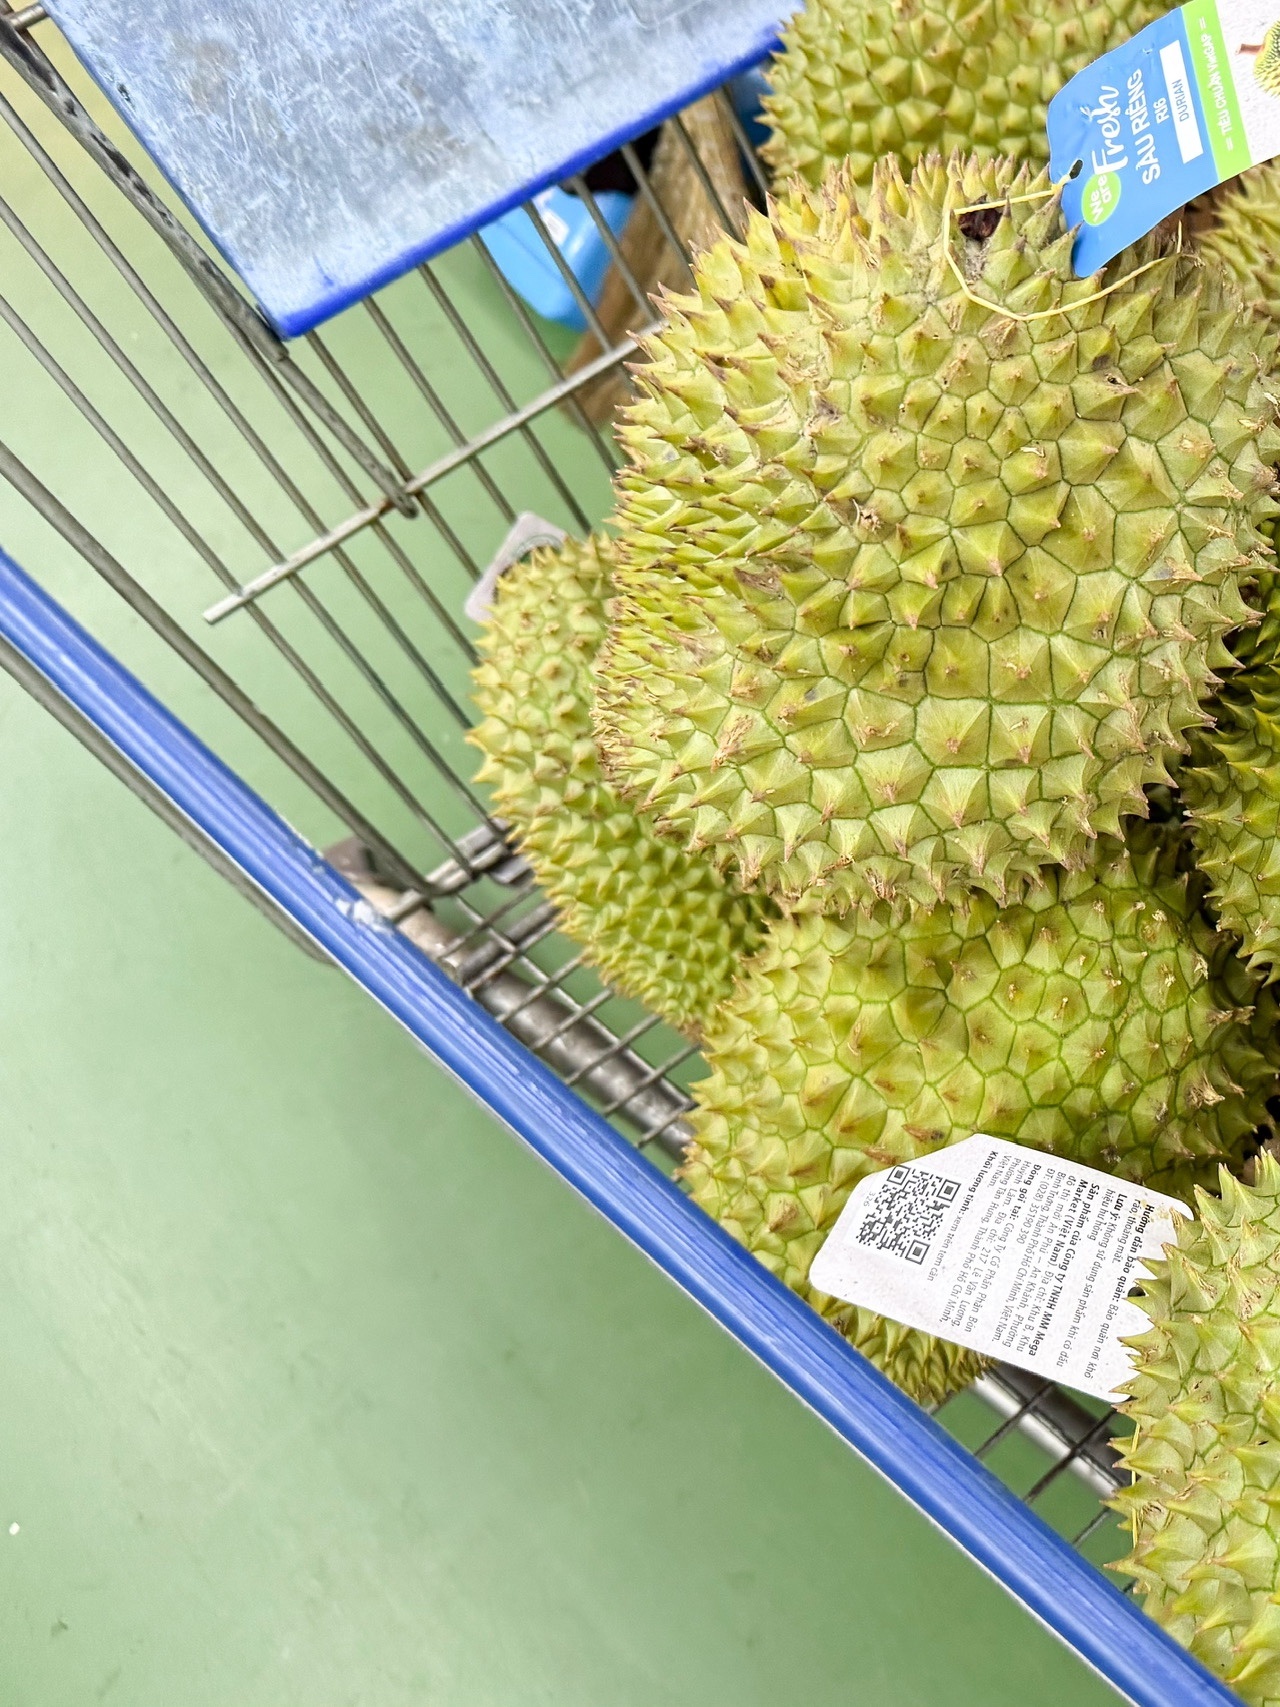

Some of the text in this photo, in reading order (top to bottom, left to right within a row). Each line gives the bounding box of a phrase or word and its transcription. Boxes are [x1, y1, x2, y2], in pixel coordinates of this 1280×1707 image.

[1125, 69, 1151, 135] RIÊNG
[1171, 80, 1190, 123] DURIAN
[1092, 85, 1129, 175] Fresh
[1096, 173, 1114, 204] are
[1088, 191, 1104, 221] We
[1032, 1180, 1049, 1201] (028)
[1067, 1178, 1090, 1213] Market
[949, 1215, 962, 1231] xem
[997, 1221, 1014, 1242] Công
[1046, 1221, 1060, 1234] An
[933, 1249, 946, 1266] tem
[977, 1246, 991, 1264] 217
[1046, 1239, 1065, 1268] Nam).
[1057, 1247, 1076, 1271] Công
[1029, 1265, 1041, 1279] An
[1053, 1272, 1066, 1283] ty
[1045, 1284, 1063, 1310] TNHH
[1027, 1303, 1041, 1322] Khu
[1038, 1310, 1053, 1329] MM
[1016, 1334, 1031, 1352] Khu
[1026, 1329, 1045, 1356] Mega
